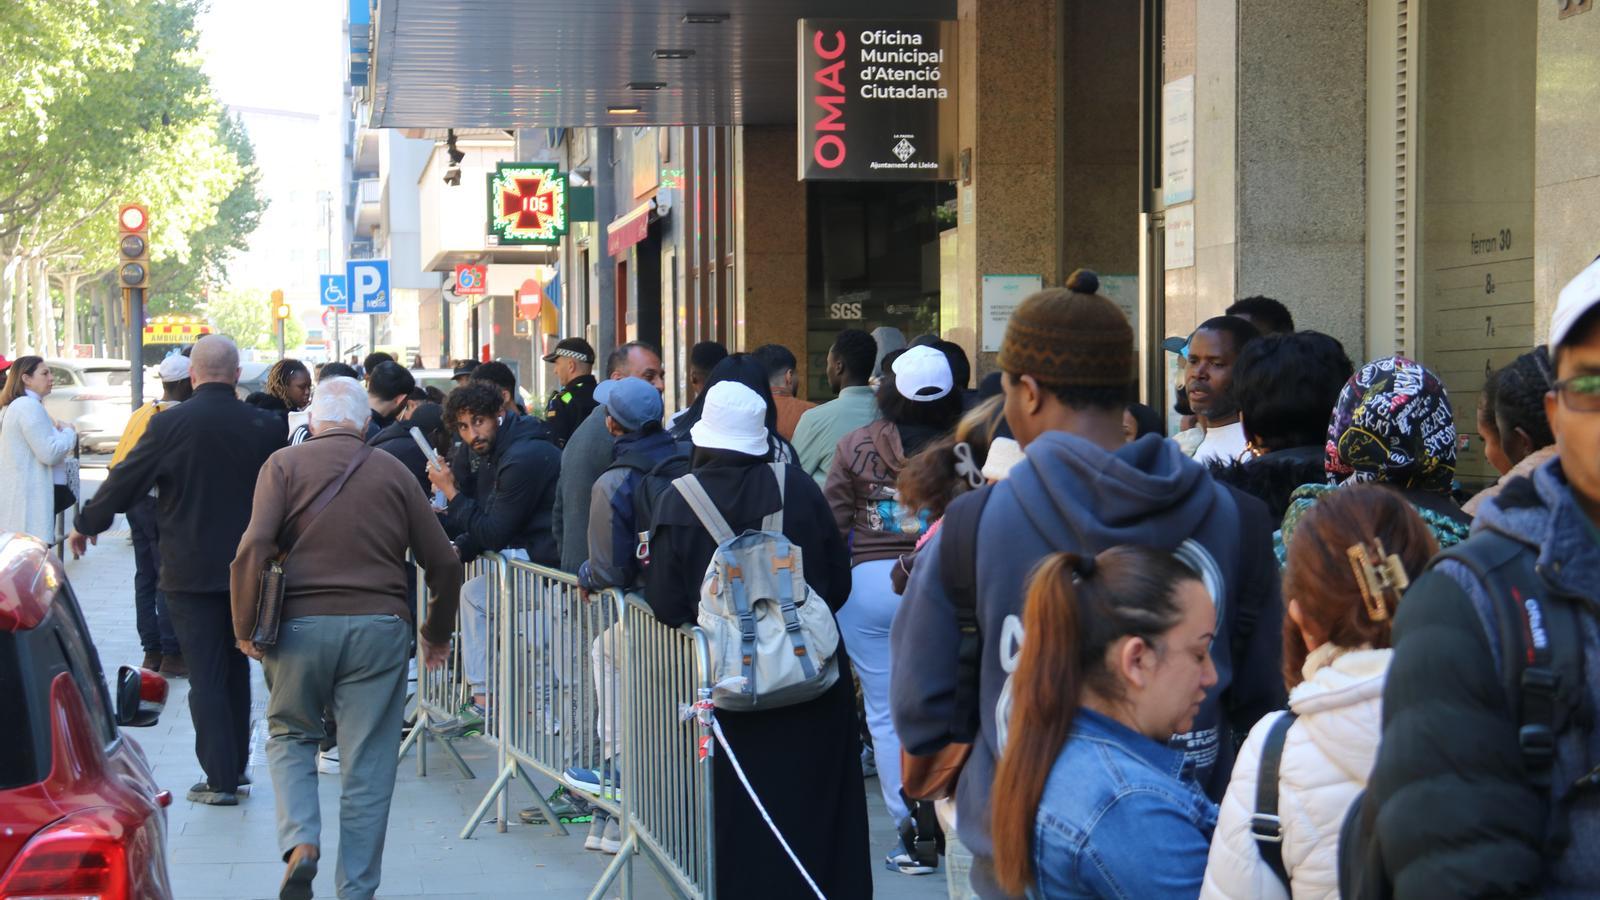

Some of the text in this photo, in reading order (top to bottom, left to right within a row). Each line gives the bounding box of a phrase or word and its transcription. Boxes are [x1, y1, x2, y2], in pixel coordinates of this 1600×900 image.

[860, 30, 923, 45] Oficina
[860, 48, 944, 66] Municipal
[860, 66, 941, 81] d'Atenció
[813, 30, 847, 169] OMAC
[860, 85, 948, 99] Ciutadana
[522, 196, 549, 212] 106
[1471, 228, 1511, 256] ferran 30
[352, 266, 382, 312] P
[830, 302, 862, 320] SGS
